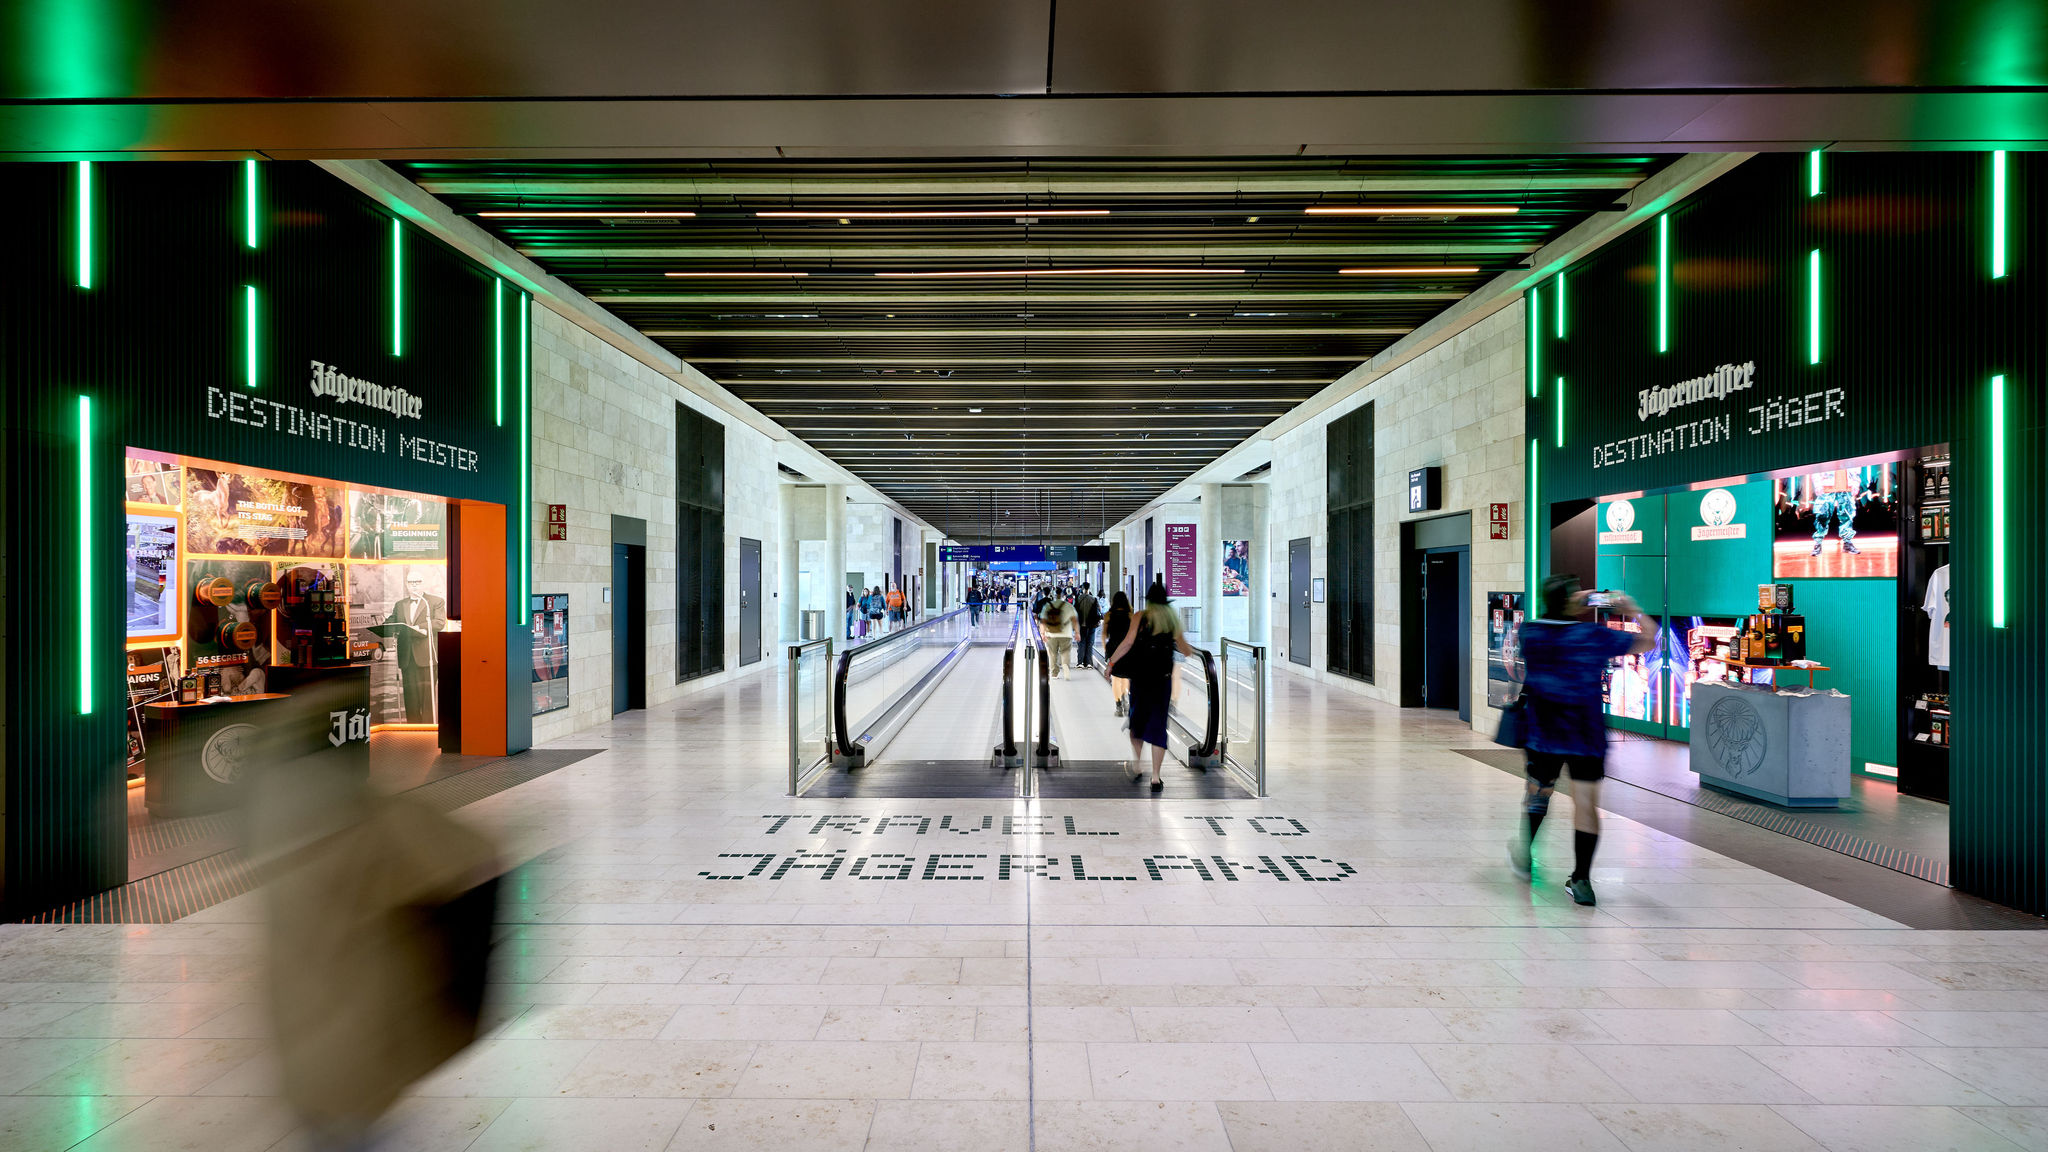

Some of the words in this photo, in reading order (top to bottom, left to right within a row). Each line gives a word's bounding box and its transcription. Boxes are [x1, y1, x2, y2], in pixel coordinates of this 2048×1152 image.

[310, 360, 423, 420] Jägermeister
[1638, 361, 1755, 421] Jägermeister
[208, 386, 385, 453] DESTINATION
[400, 433, 478, 473] MEISTER
[1593, 413, 1730, 469] DESTINATION
[1748, 387, 1845, 435] JÄGER
[237, 500, 254, 509] THE
[255, 502, 285, 512] BOTTLE
[286, 505, 302, 513] GOT
[238, 511, 251, 520] ITS
[252, 512, 273, 521] STAG
[353, 640, 369, 648] CURT
[353, 650, 370, 658] MAST
[197, 656, 209, 664] 56
[210, 652, 248, 663] SECRETS
[762, 815, 1120, 835] TRAVEL
[1184, 816, 1311, 836] TO
[697, 849, 1359, 882] JÄGERLAND
